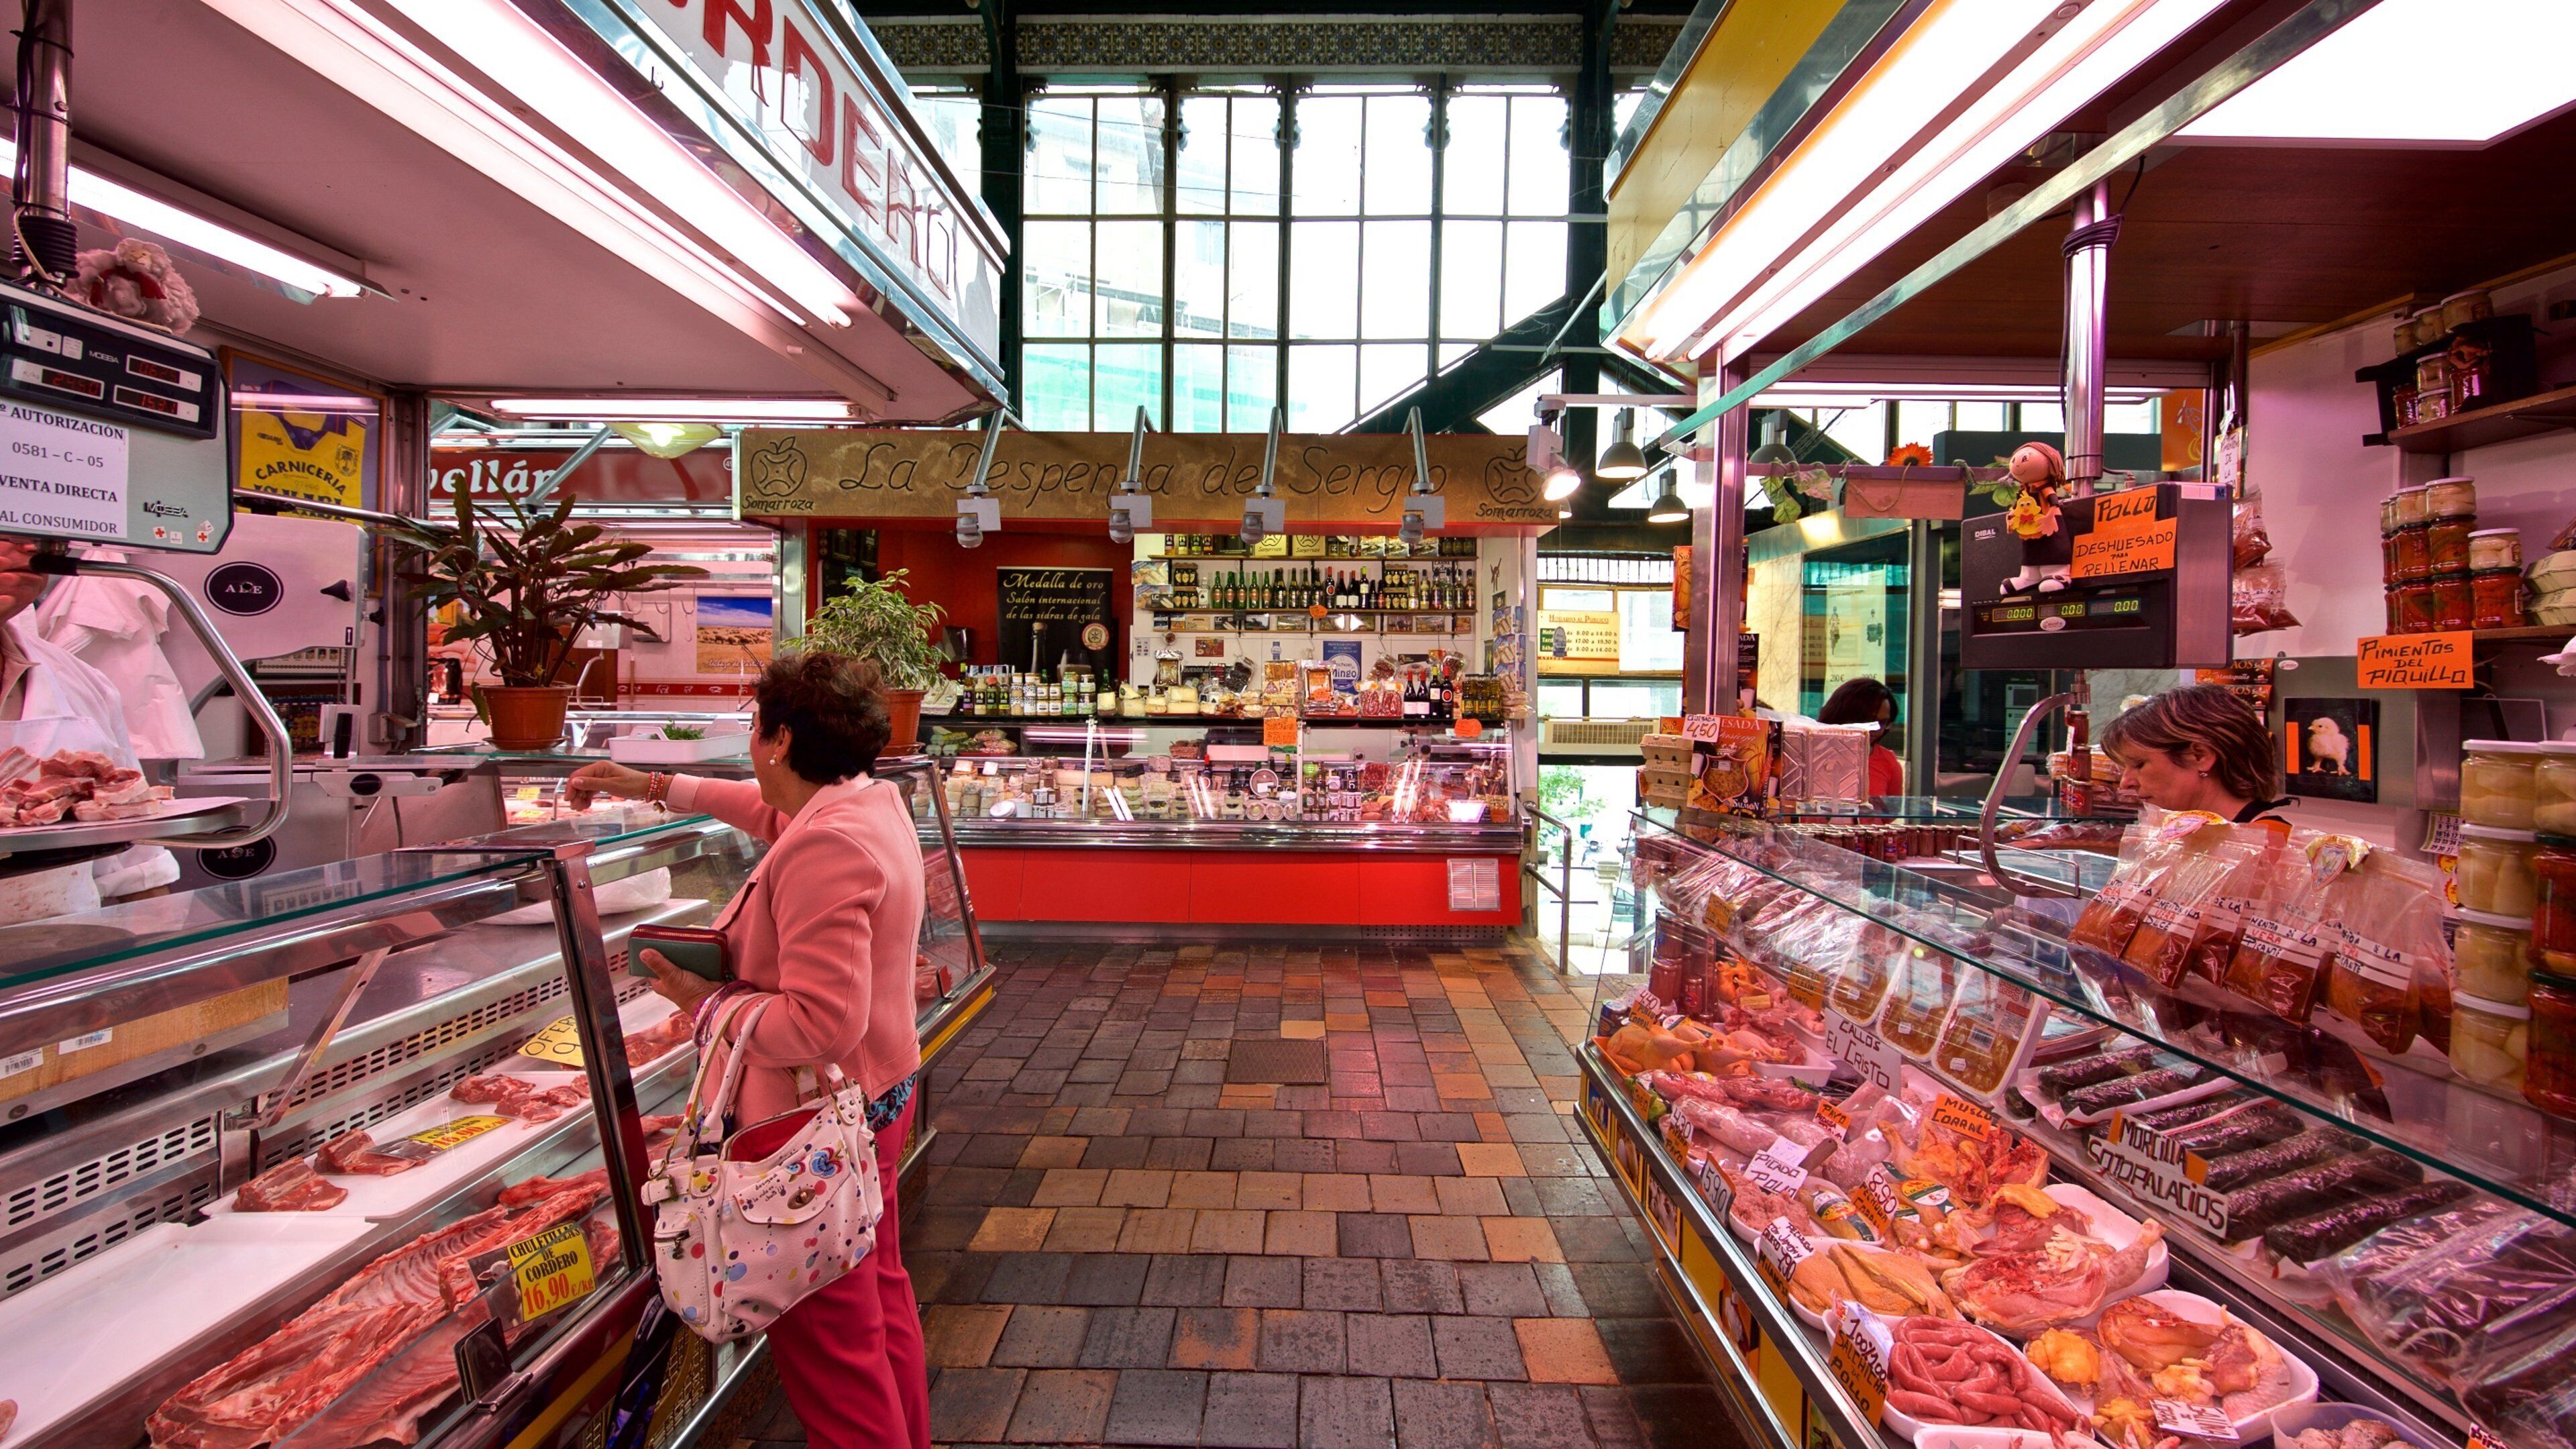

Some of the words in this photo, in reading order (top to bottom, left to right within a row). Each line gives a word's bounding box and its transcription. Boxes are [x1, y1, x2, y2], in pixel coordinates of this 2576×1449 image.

[665, 0, 957, 301] RDERO
[11, 406, 124, 440] AUTORIZACIÓN
[13, 441, 48, 459] 0581
[64, 451, 73, 463] C
[88, 455, 103, 468] 05
[255, 460, 346, 496] CARNICERIA
[839, 442, 918, 492] La
[945, 442, 1175, 508] Despena
[1202, 446, 1259, 496] de
[0, 475, 50, 493] VENTA
[55, 482, 118, 502] DIRECTA
[742, 495, 814, 513] Somarroza
[1476, 503, 1553, 521] Somarroza
[2097, 495, 2156, 523] POLLO
[0, 511, 19, 523] AL
[22, 513, 118, 534] CONSUMIDOR
[1974, 529, 1996, 538] DIBAL
[2075, 531, 2174, 557] DESHUESADO
[2110, 551, 2129, 559] PARA
[2084, 557, 2160, 576] RELLENAR
[1003, 572, 1065, 589] Medalla
[1069, 572, 1084, 589] de
[1086, 582, 1104, 590] oro
[1006, 590, 1036, 604] Salón
[1039, 592, 1106, 604] internacional
[2114, 600, 2139, 612] 0.00
[1006, 605, 1018, 620] de
[1020, 605, 1033, 620] las
[1035, 606, 1065, 621] sidras
[1067, 606, 1079, 621] de
[1078, 606, 1101, 624] gala
[2061, 604, 2083, 616] 0.00
[2394, 659, 2424, 668] DEL
[1721, 718, 1761, 731] ESADA
[2251, 928, 2282, 944] VERA
[1826, 1030, 1838, 1055] EL
[1839, 1019, 1881, 1052] CALLOS
[1944, 1097, 1992, 1121] MUSLO
[1931, 1108, 1984, 1136] CORRAL
[1754, 1152, 1801, 1178] PICADO
[1868, 1171, 1898, 1215] 8.90
[541, 1247, 555, 1261] DE
[525, 1250, 579, 1283] CORDERO
[524, 1273, 570, 1315] 16,90
[1830, 1355, 1870, 1412] POLLO
